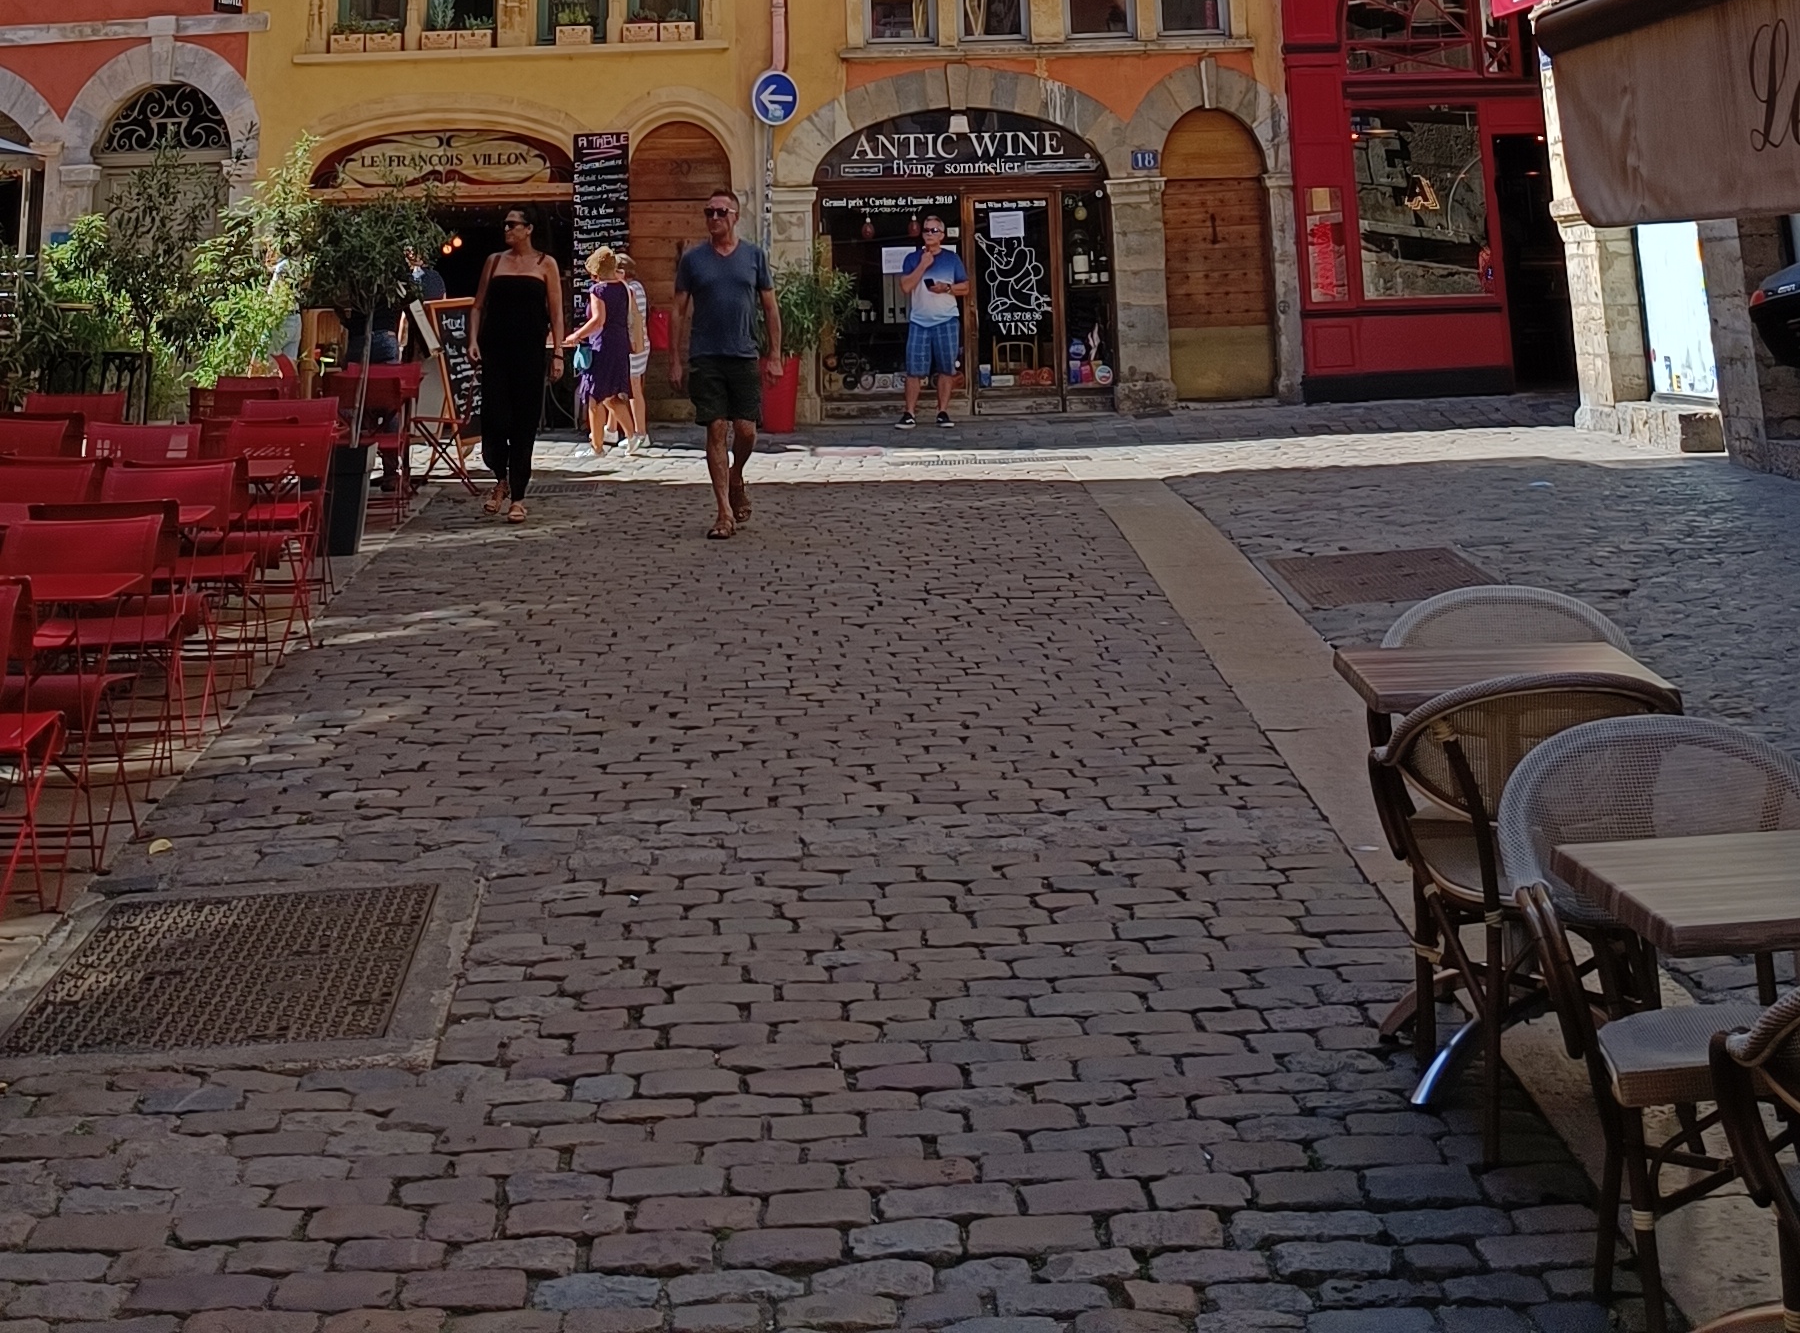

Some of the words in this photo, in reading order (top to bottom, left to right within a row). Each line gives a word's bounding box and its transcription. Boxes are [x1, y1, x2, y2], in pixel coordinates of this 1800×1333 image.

[1749, 18, 1800, 152] L
[851, 132, 959, 160] ANTIC
[967, 130, 1065, 158] WINE
[360, 155, 380, 168] LE
[472, 151, 529, 166] VILLON
[893, 159, 935, 178] flying
[944, 158, 1022, 175] sommelier
[1136, 153, 1155, 168] 18
[998, 321, 1038, 336] VINS
